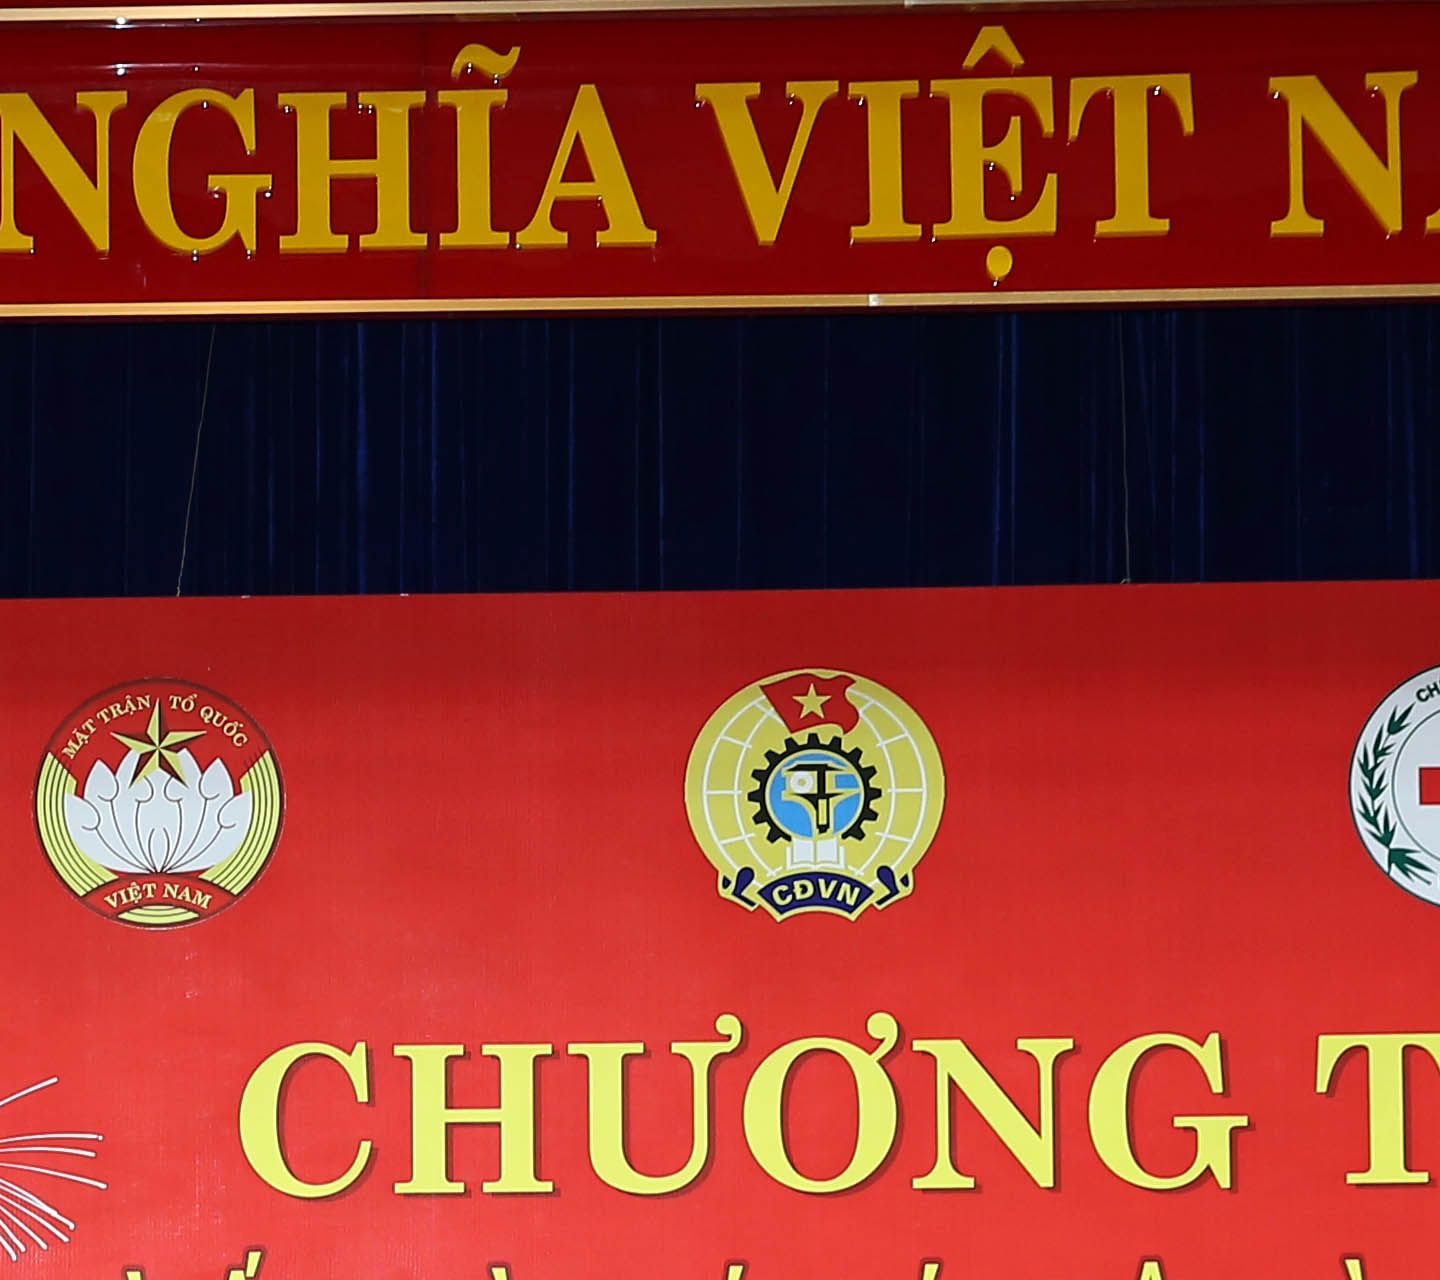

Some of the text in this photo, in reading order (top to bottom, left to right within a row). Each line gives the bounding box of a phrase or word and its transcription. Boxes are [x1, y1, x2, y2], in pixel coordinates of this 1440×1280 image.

[696, 25, 1196, 284] VIỆT
[63, 693, 248, 760] MẶT TRẬN TỔ QUỐC
[104, 882, 213, 909] VIỆT NAM
[772, 878, 861, 907] CĐVN
[238, 1012, 1250, 1198] CHƯƠNG
